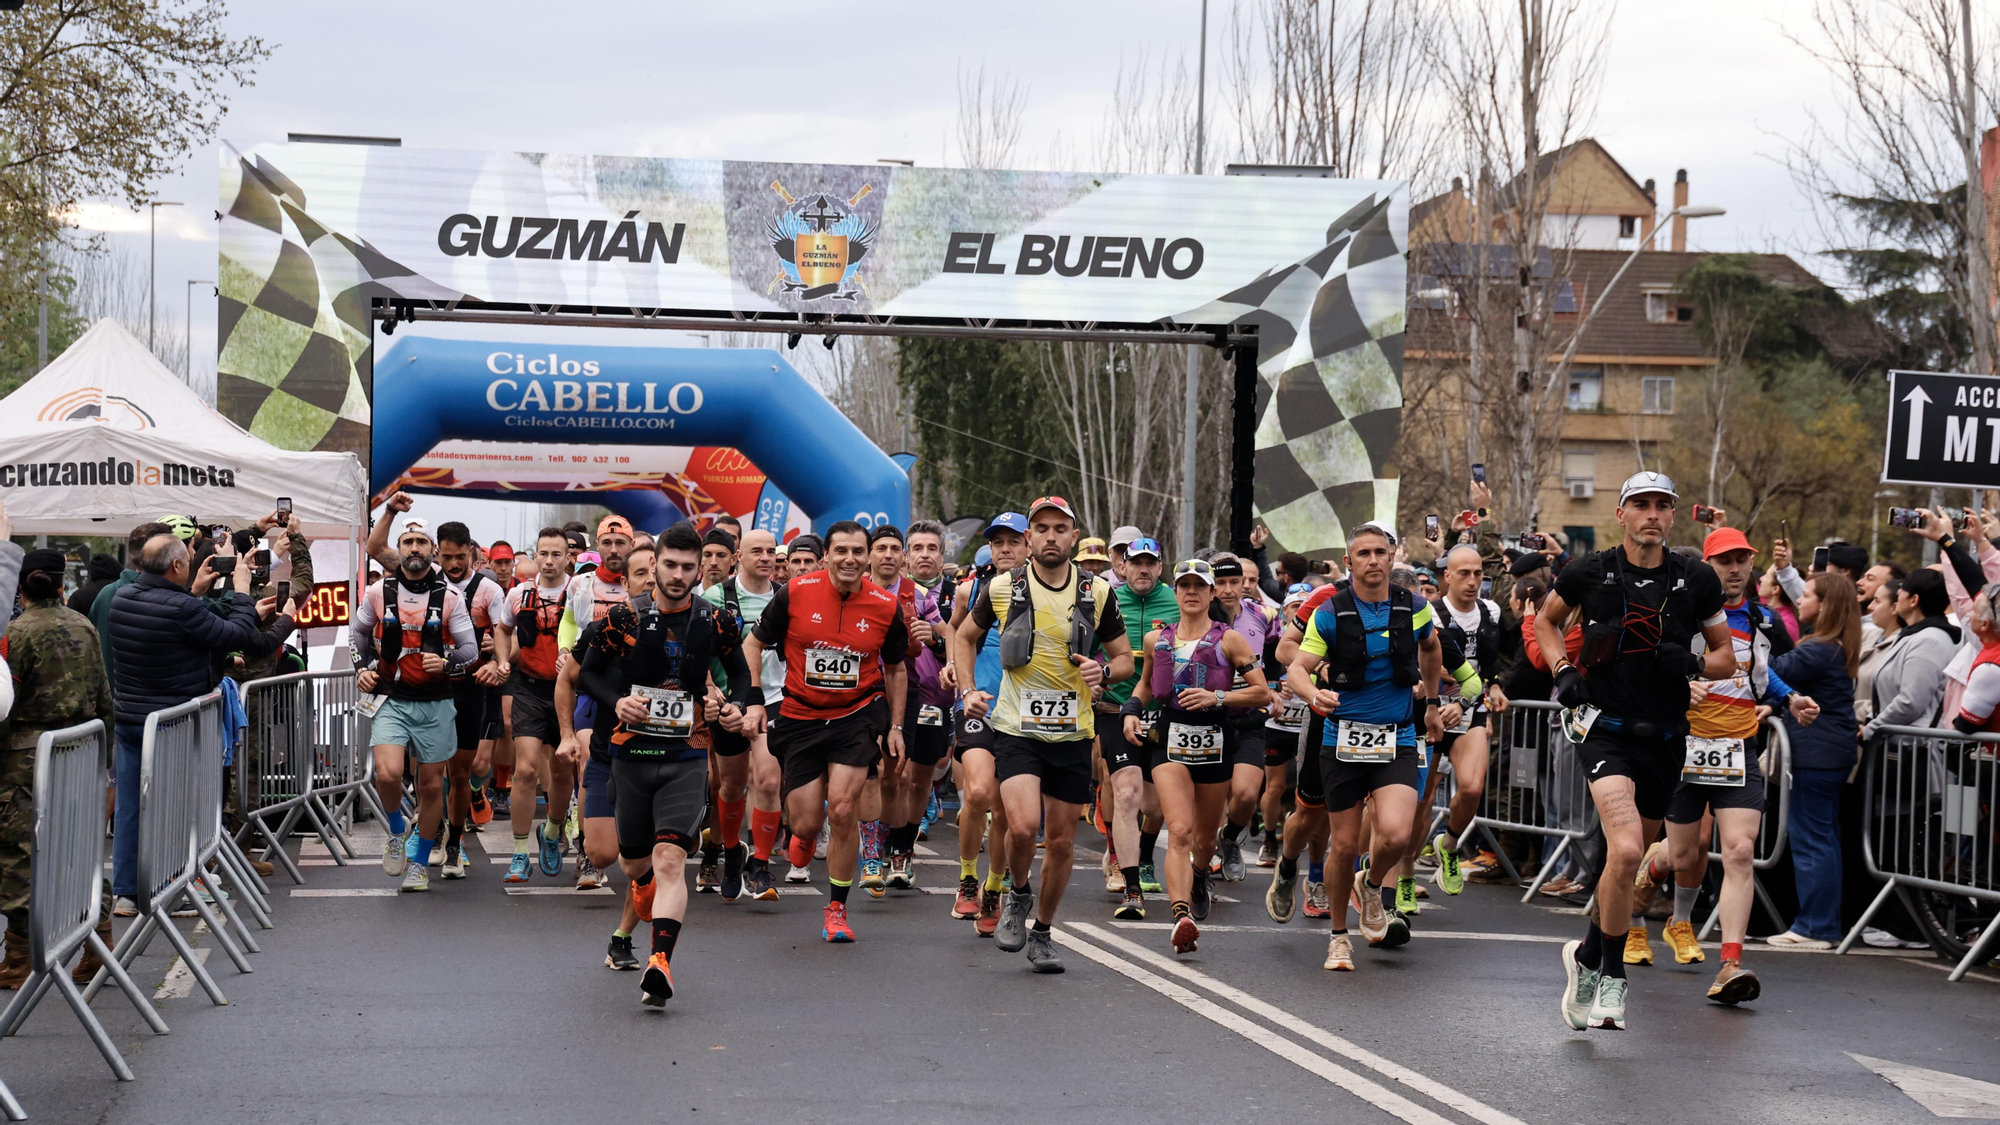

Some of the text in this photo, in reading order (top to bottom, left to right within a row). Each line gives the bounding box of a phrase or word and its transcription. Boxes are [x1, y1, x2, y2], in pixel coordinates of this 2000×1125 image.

[438, 211, 686, 264] GUZMÁN
[803, 251, 839, 259] GUZMÁN
[942, 232, 1204, 280] EL BUENO
[486, 352, 600, 377] Ciclos
[486, 379, 704, 414] CABELLO
[504, 415, 675, 429] CiclosCABELLO.COM
[593, 456, 608, 464] 432
[703, 475, 734, 484] FUERZAS
[797, 577, 821, 585] Jimbee
[869, 589, 891, 602] Jimbee
[815, 658, 851, 674] 640
[1030, 700, 1069, 716] 673
[1177, 733, 1215, 749] 393
[1347, 731, 1386, 747] 524
[1693, 750, 1732, 767] 361
